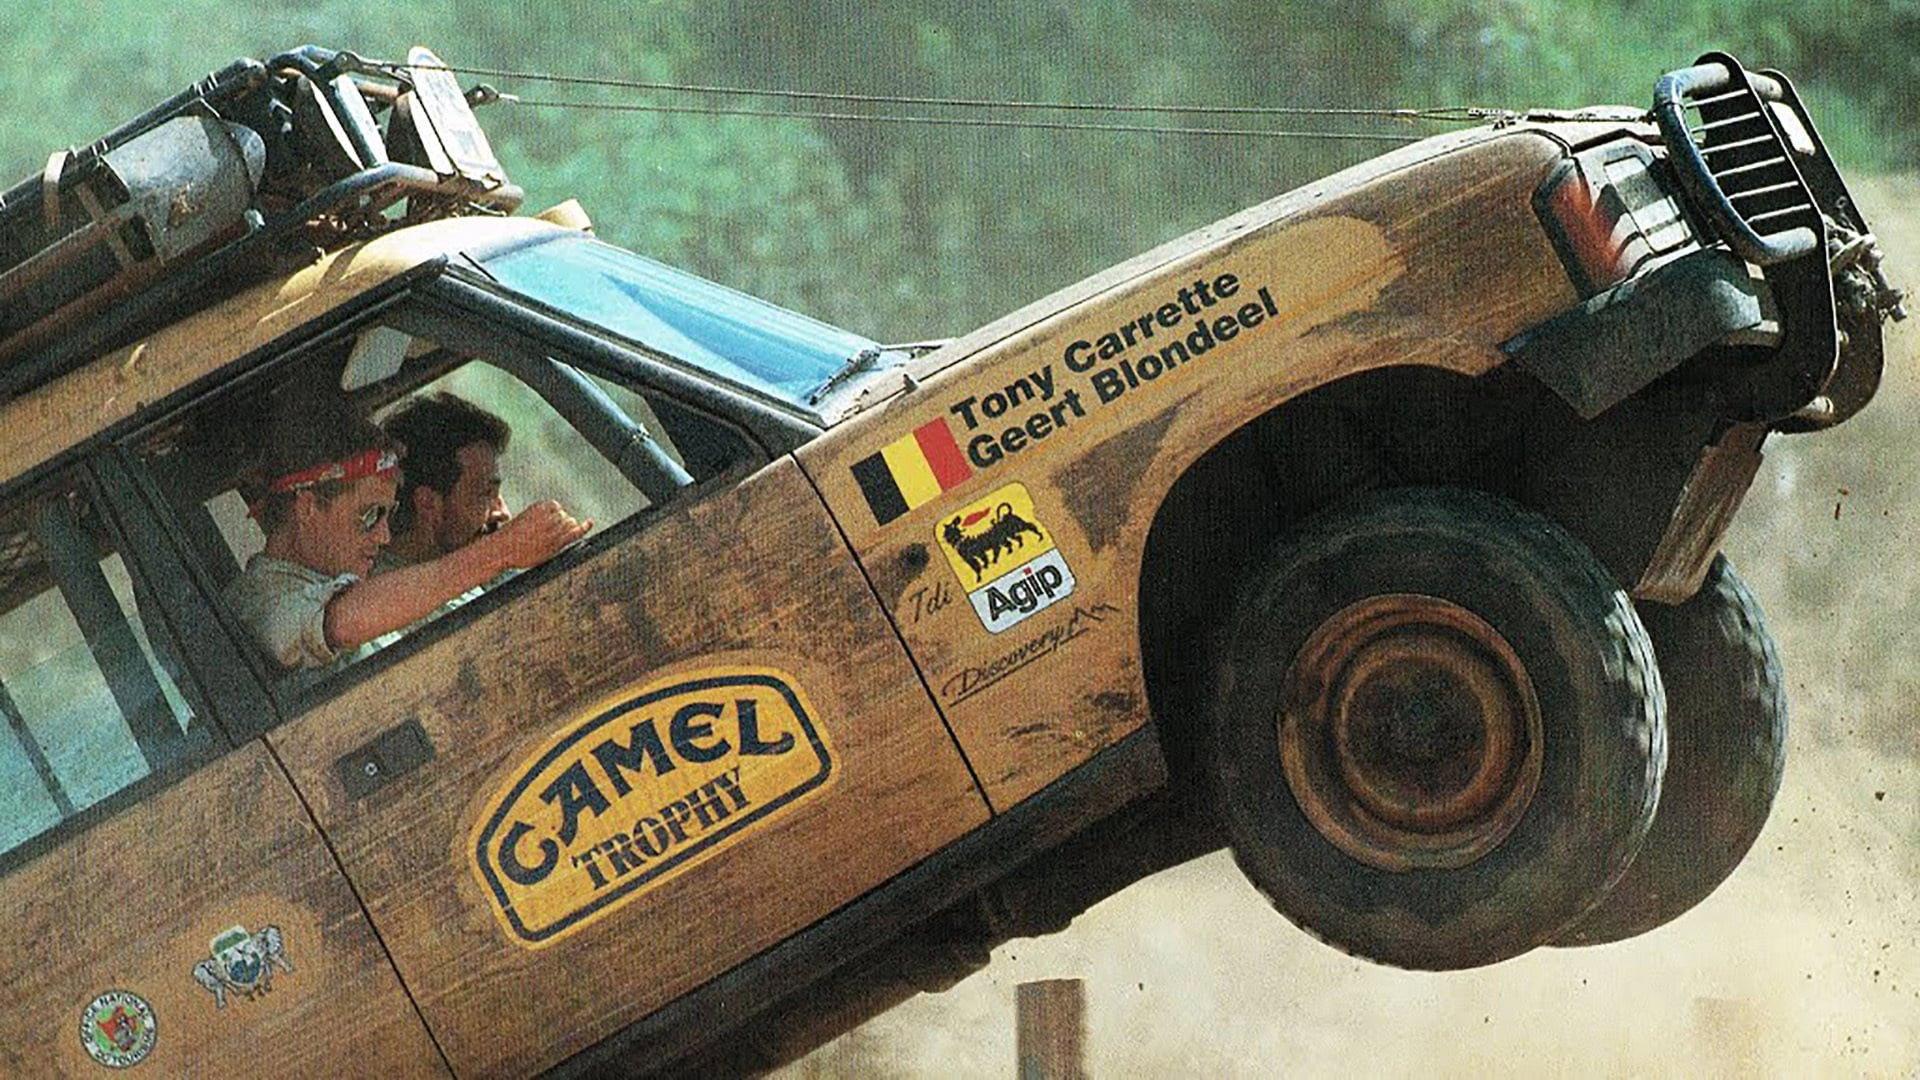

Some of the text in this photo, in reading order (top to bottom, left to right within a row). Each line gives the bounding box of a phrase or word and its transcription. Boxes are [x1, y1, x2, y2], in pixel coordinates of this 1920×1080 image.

[950, 270, 1240, 432] Tony Carrette
[967, 287, 1280, 469] Geert Blondeel
[942, 623, 1066, 697] Discovery
[984, 563, 1062, 622] Agip
[498, 699, 796, 886] CAMEL
[571, 767, 751, 891] TROPHY
